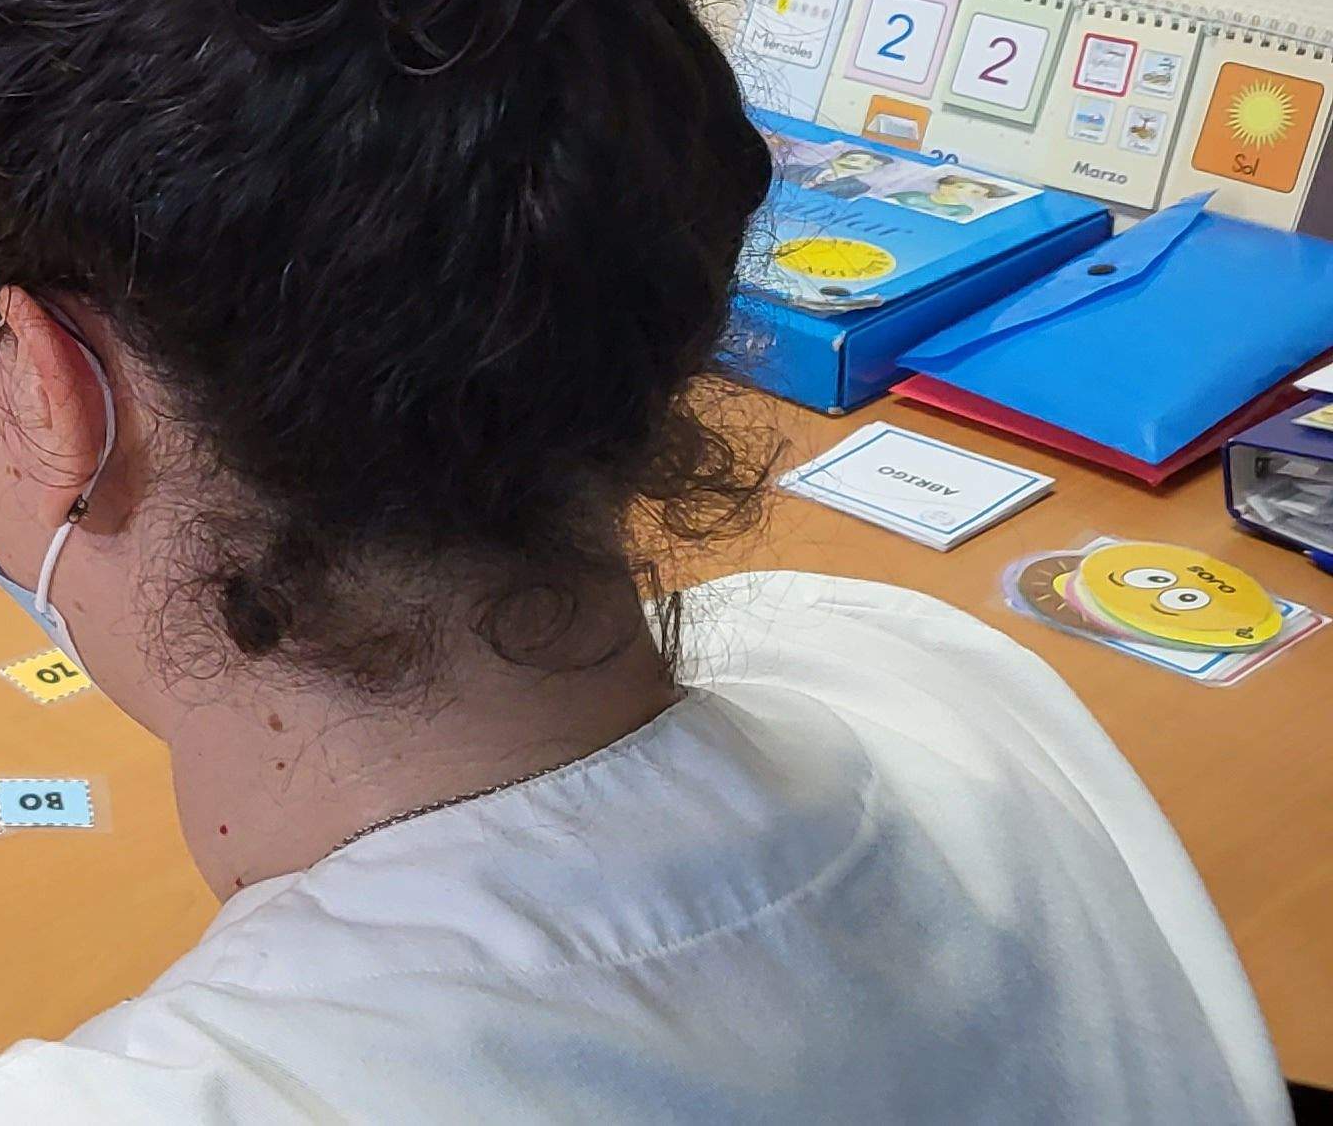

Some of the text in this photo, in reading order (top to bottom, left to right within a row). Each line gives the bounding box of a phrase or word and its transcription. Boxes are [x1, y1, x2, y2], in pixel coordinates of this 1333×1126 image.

[877, 13, 915, 62] 2
[978, 36, 1019, 86] 2
[1072, 159, 1129, 185] Marzo
[1232, 153, 1261, 177] Sol
[877, 465, 961, 496] ABRIGO
[19, 791, 65, 812] BO
